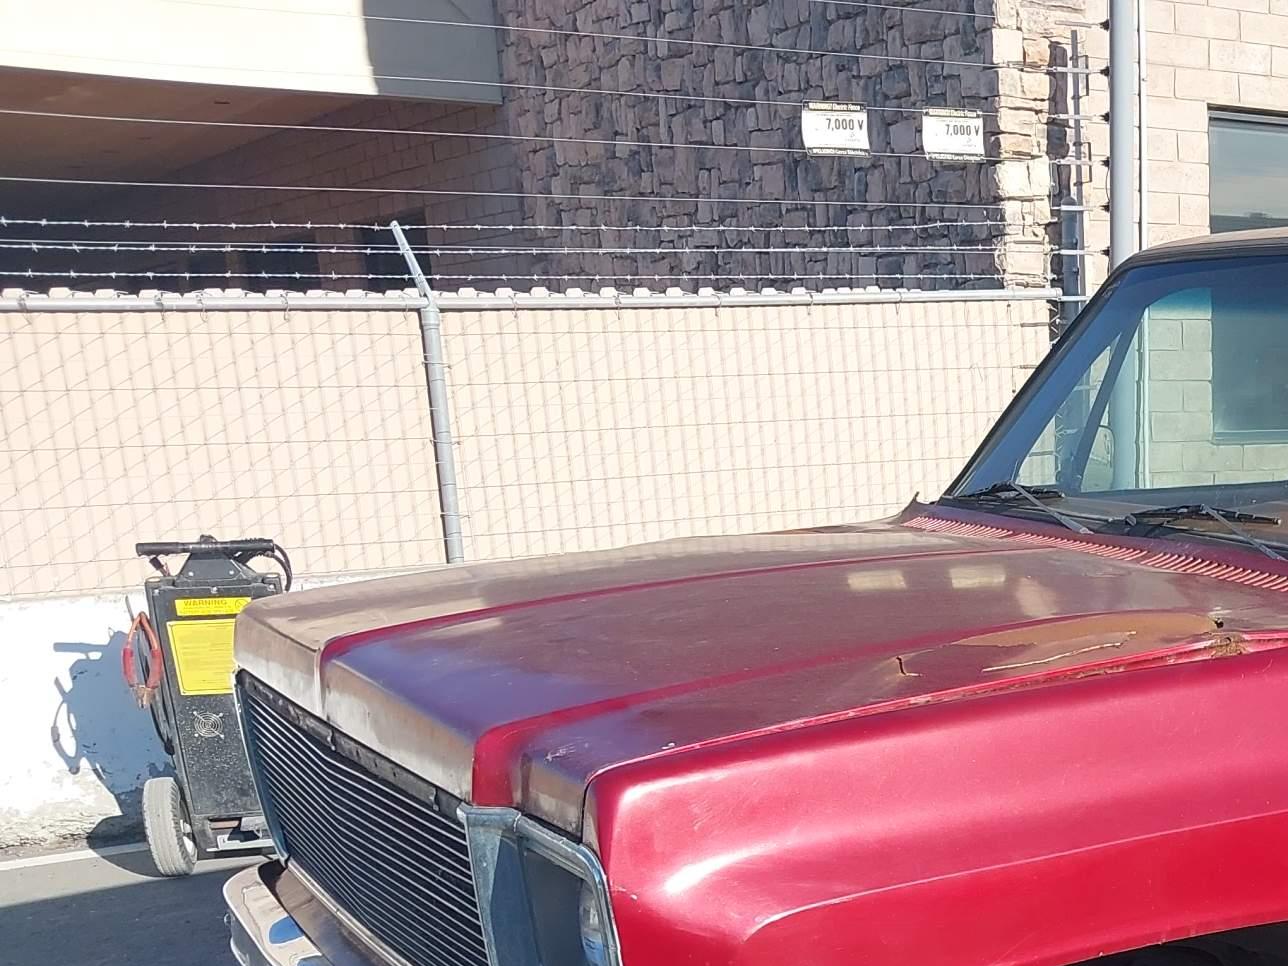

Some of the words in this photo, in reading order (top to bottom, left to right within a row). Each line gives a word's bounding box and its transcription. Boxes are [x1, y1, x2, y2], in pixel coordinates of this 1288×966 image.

[826, 118, 854, 131] 7,000
[858, 119, 864, 130] V
[945, 124, 971, 136] 7,000
[974, 125, 980, 136] V
[183, 599, 227, 607] WARNING
